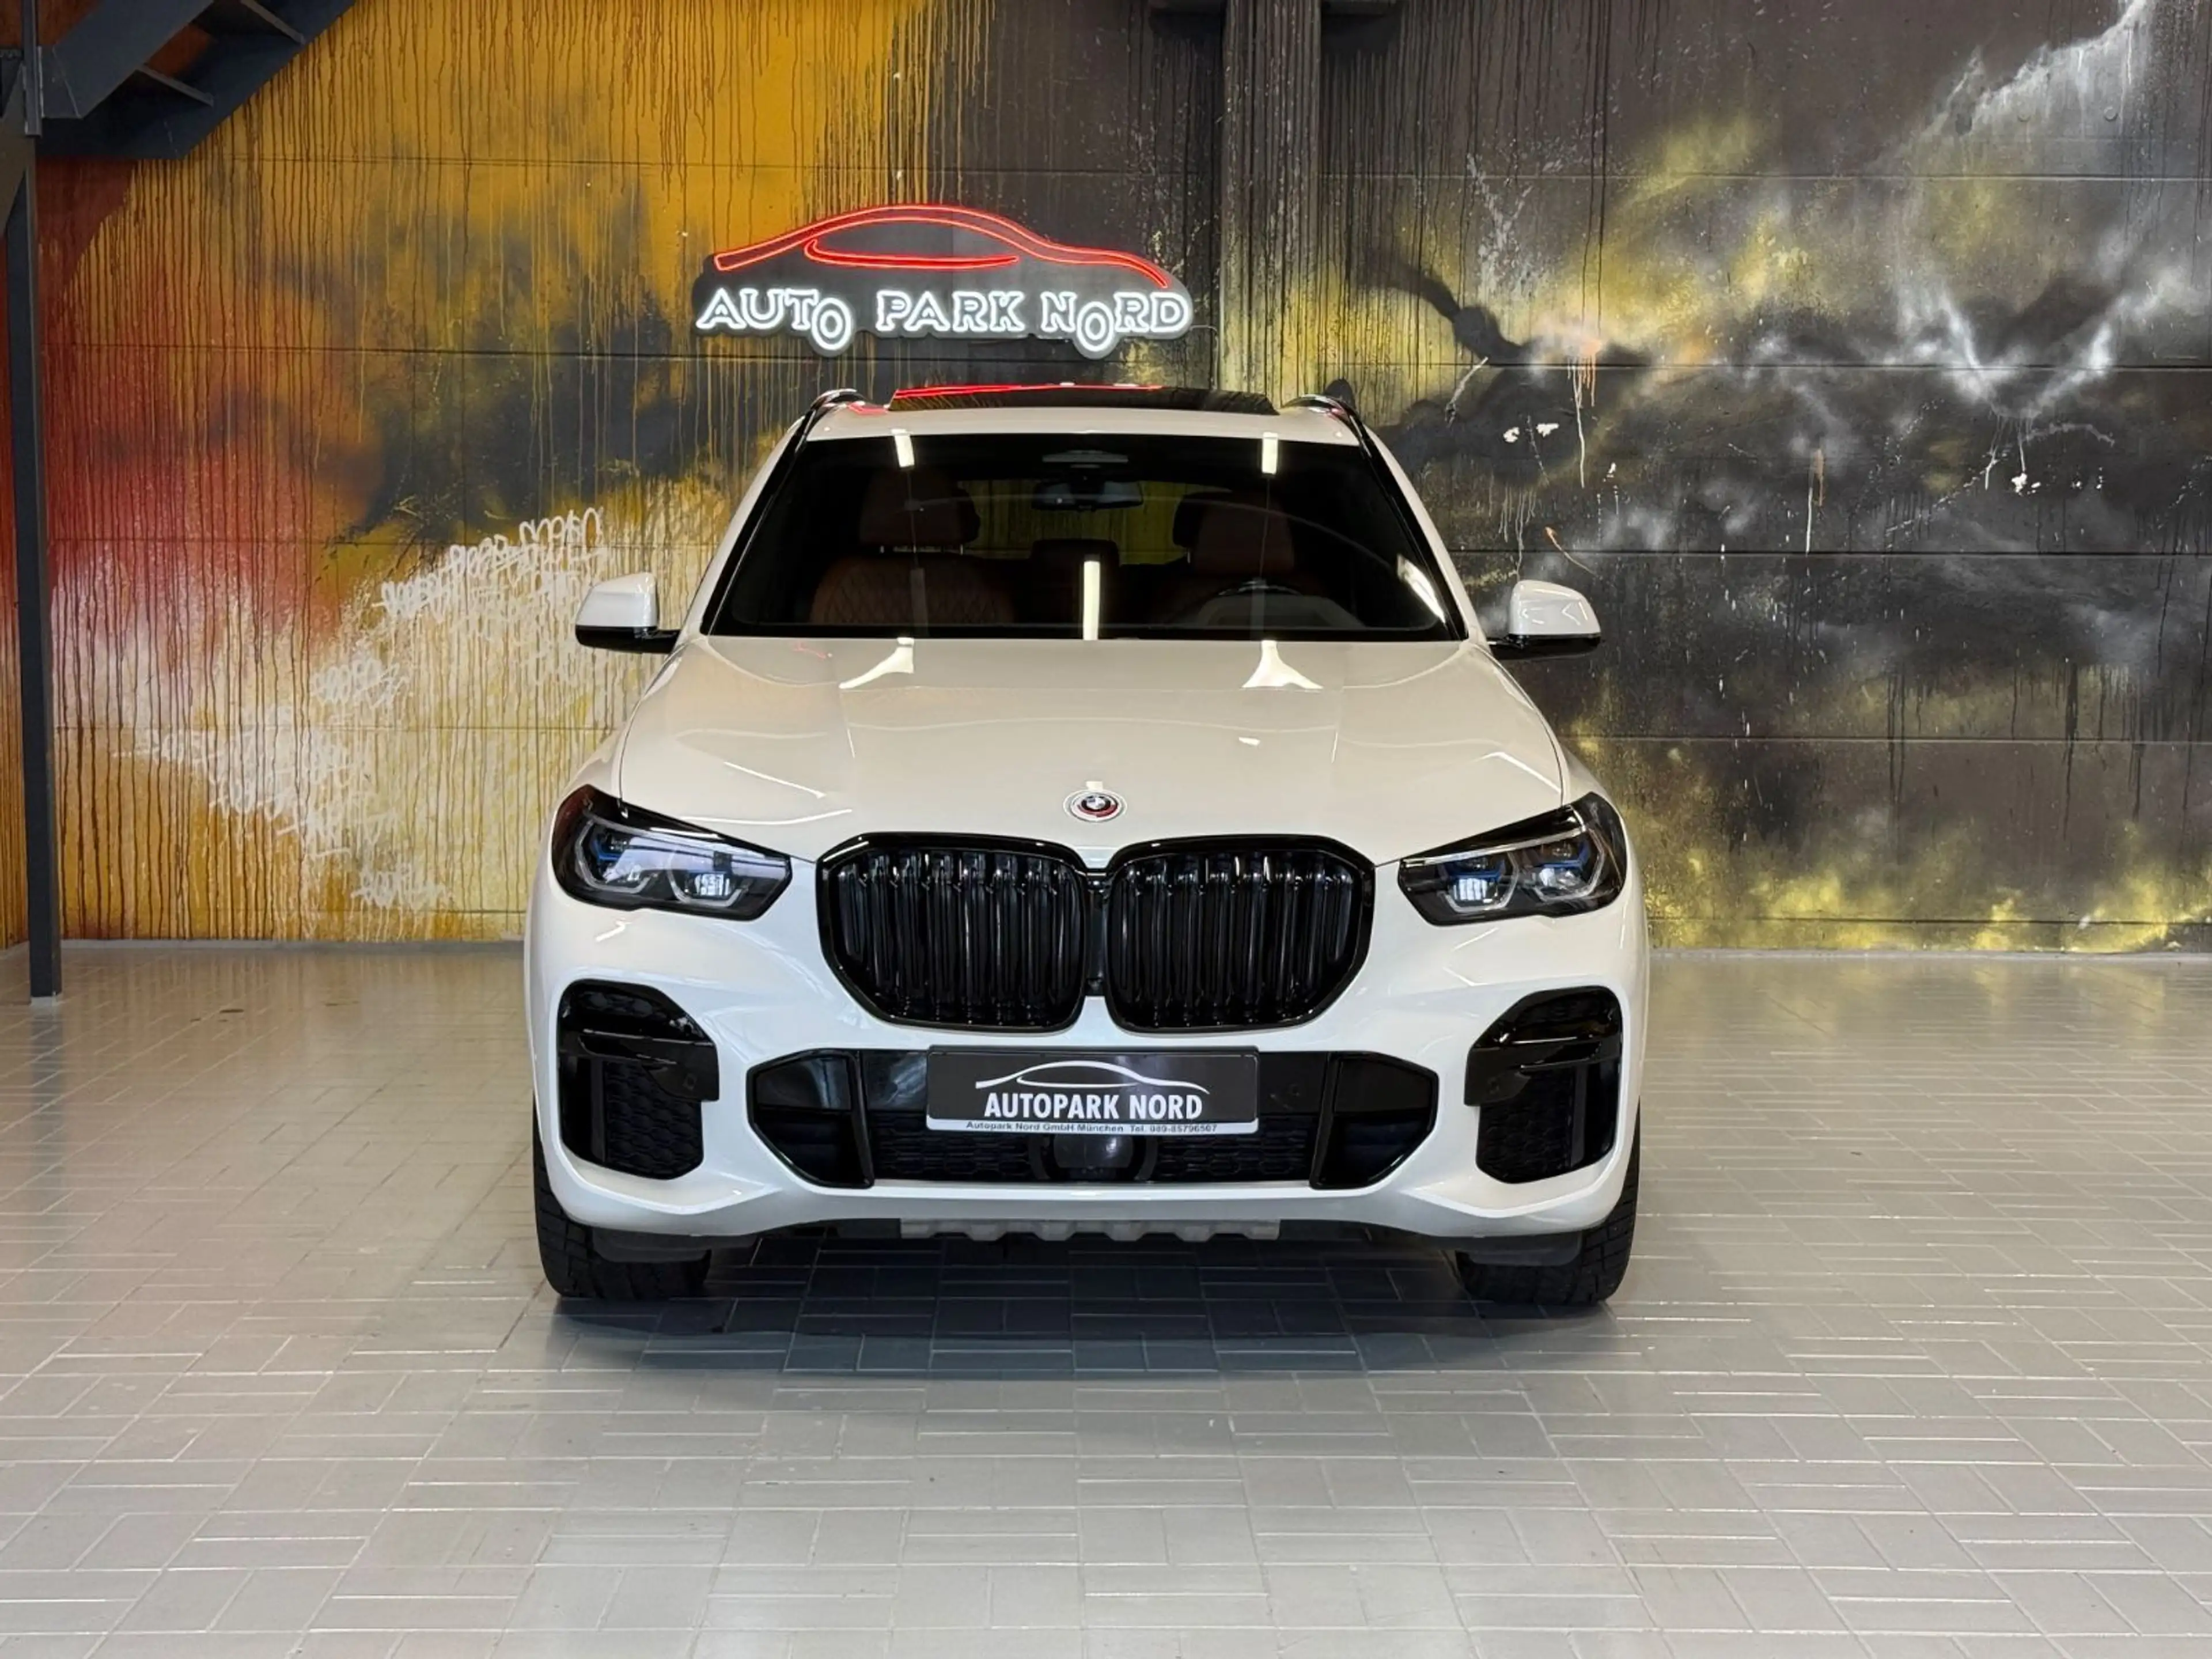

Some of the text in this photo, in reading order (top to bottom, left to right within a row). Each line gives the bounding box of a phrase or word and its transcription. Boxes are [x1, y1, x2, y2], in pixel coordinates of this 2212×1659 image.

[696, 287, 1190, 353] AUTO PARK NORD
[984, 1093, 1203, 1120] AUTOPARK NORD
[966, 1121, 1011, 1131] Autopark
[1016, 1122, 1039, 1131] Nord
[1043, 1123, 1074, 1131] GmbH
[1077, 1122, 1124, 1132] München
